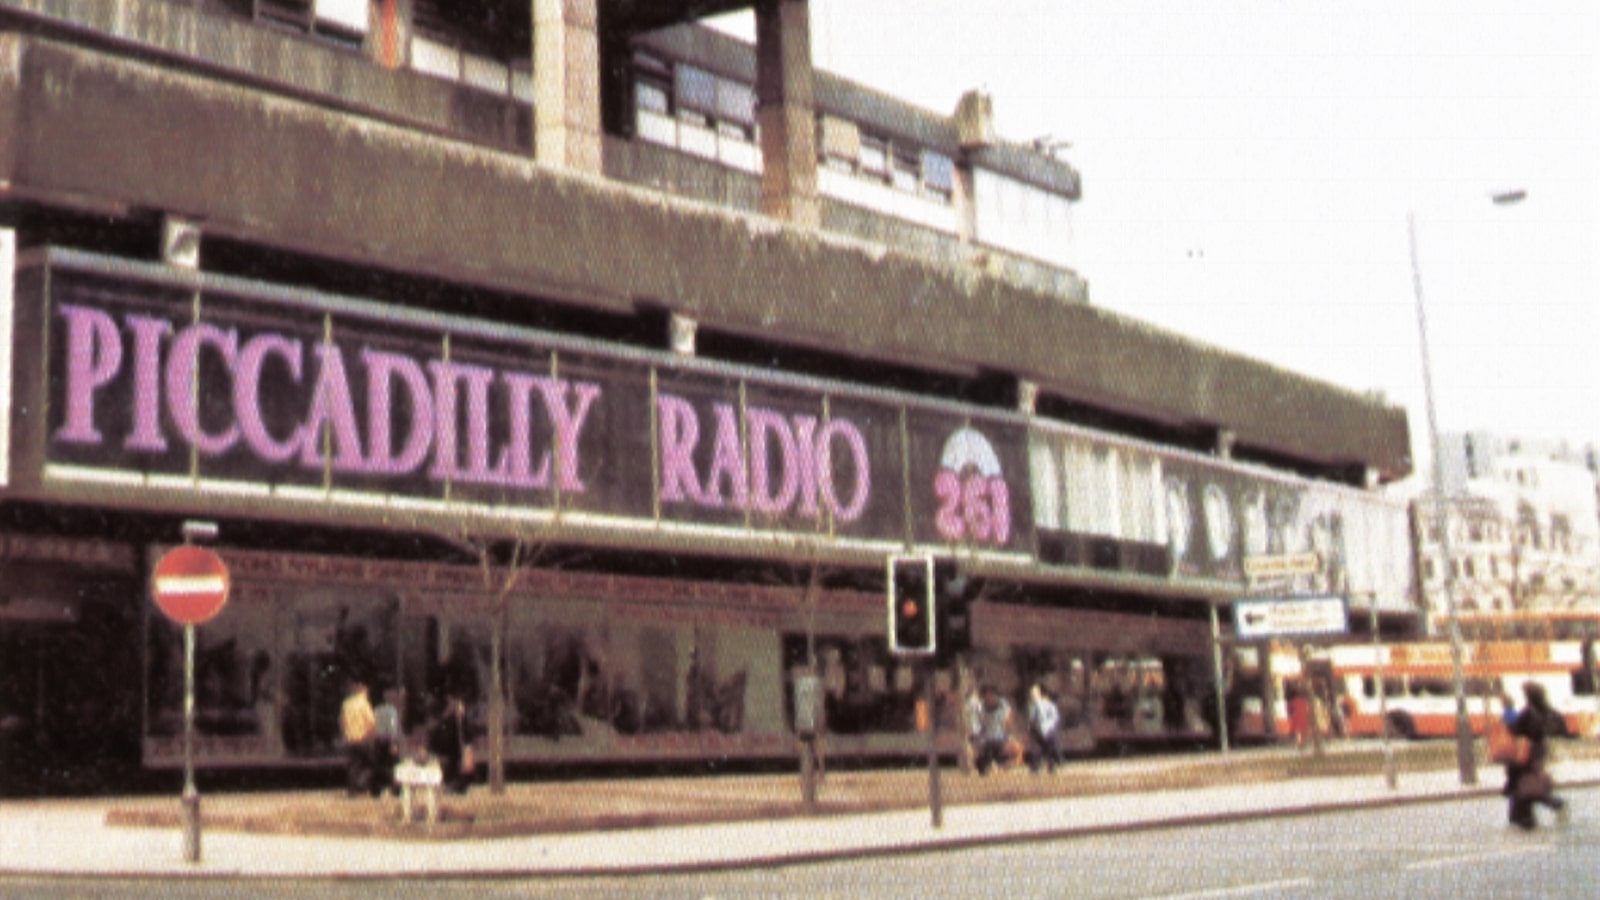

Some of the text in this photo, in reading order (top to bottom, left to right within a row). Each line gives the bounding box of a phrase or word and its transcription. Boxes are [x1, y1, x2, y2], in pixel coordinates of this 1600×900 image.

[54, 304, 871, 522] PICCADILLY RADIO
[935, 467, 1012, 544] 261
